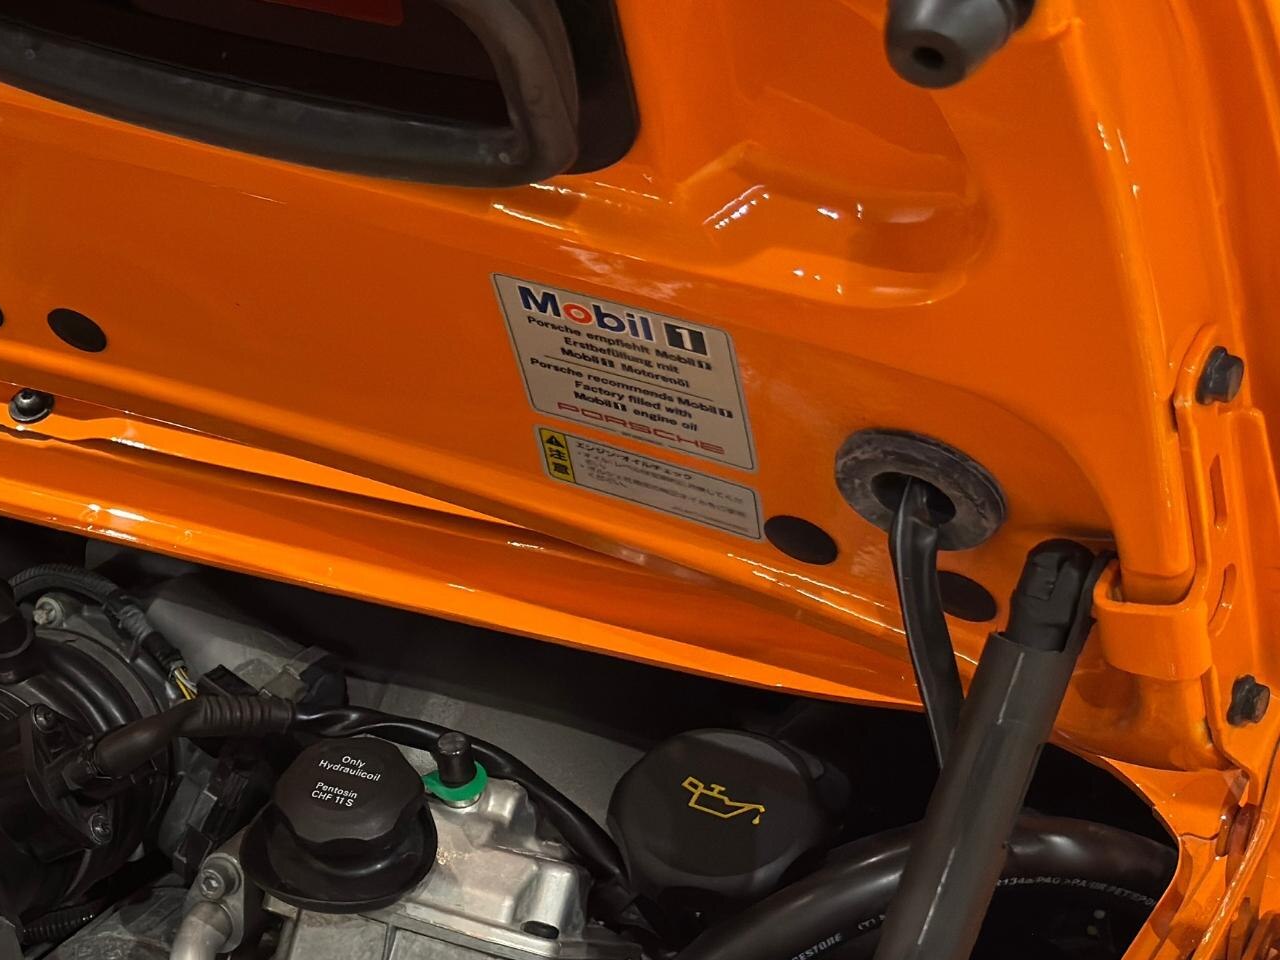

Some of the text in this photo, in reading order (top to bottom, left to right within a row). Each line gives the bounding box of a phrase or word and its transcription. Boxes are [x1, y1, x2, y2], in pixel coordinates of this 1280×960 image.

[518, 285, 654, 341] Mobil
[527, 316, 582, 337] Porsche
[587, 332, 650, 355] empfiehlt
[564, 337, 680, 375] Erstbefüllung mit
[530, 357, 583, 378] Porsche
[587, 373, 674, 402] recommends
[620, 364, 690, 389] Motorenöl
[574, 380, 693, 420] Factory filled with
[557, 402, 725, 454] PORSCHE
[633, 408, 678, 427] engine
[681, 419, 699, 432] oil
[318, 759, 381, 782] Hydraulicoil
[341, 755, 366, 769] Only
[311, 790, 354, 807] CHF 11 S
[315, 781, 358, 799] Pentosin
